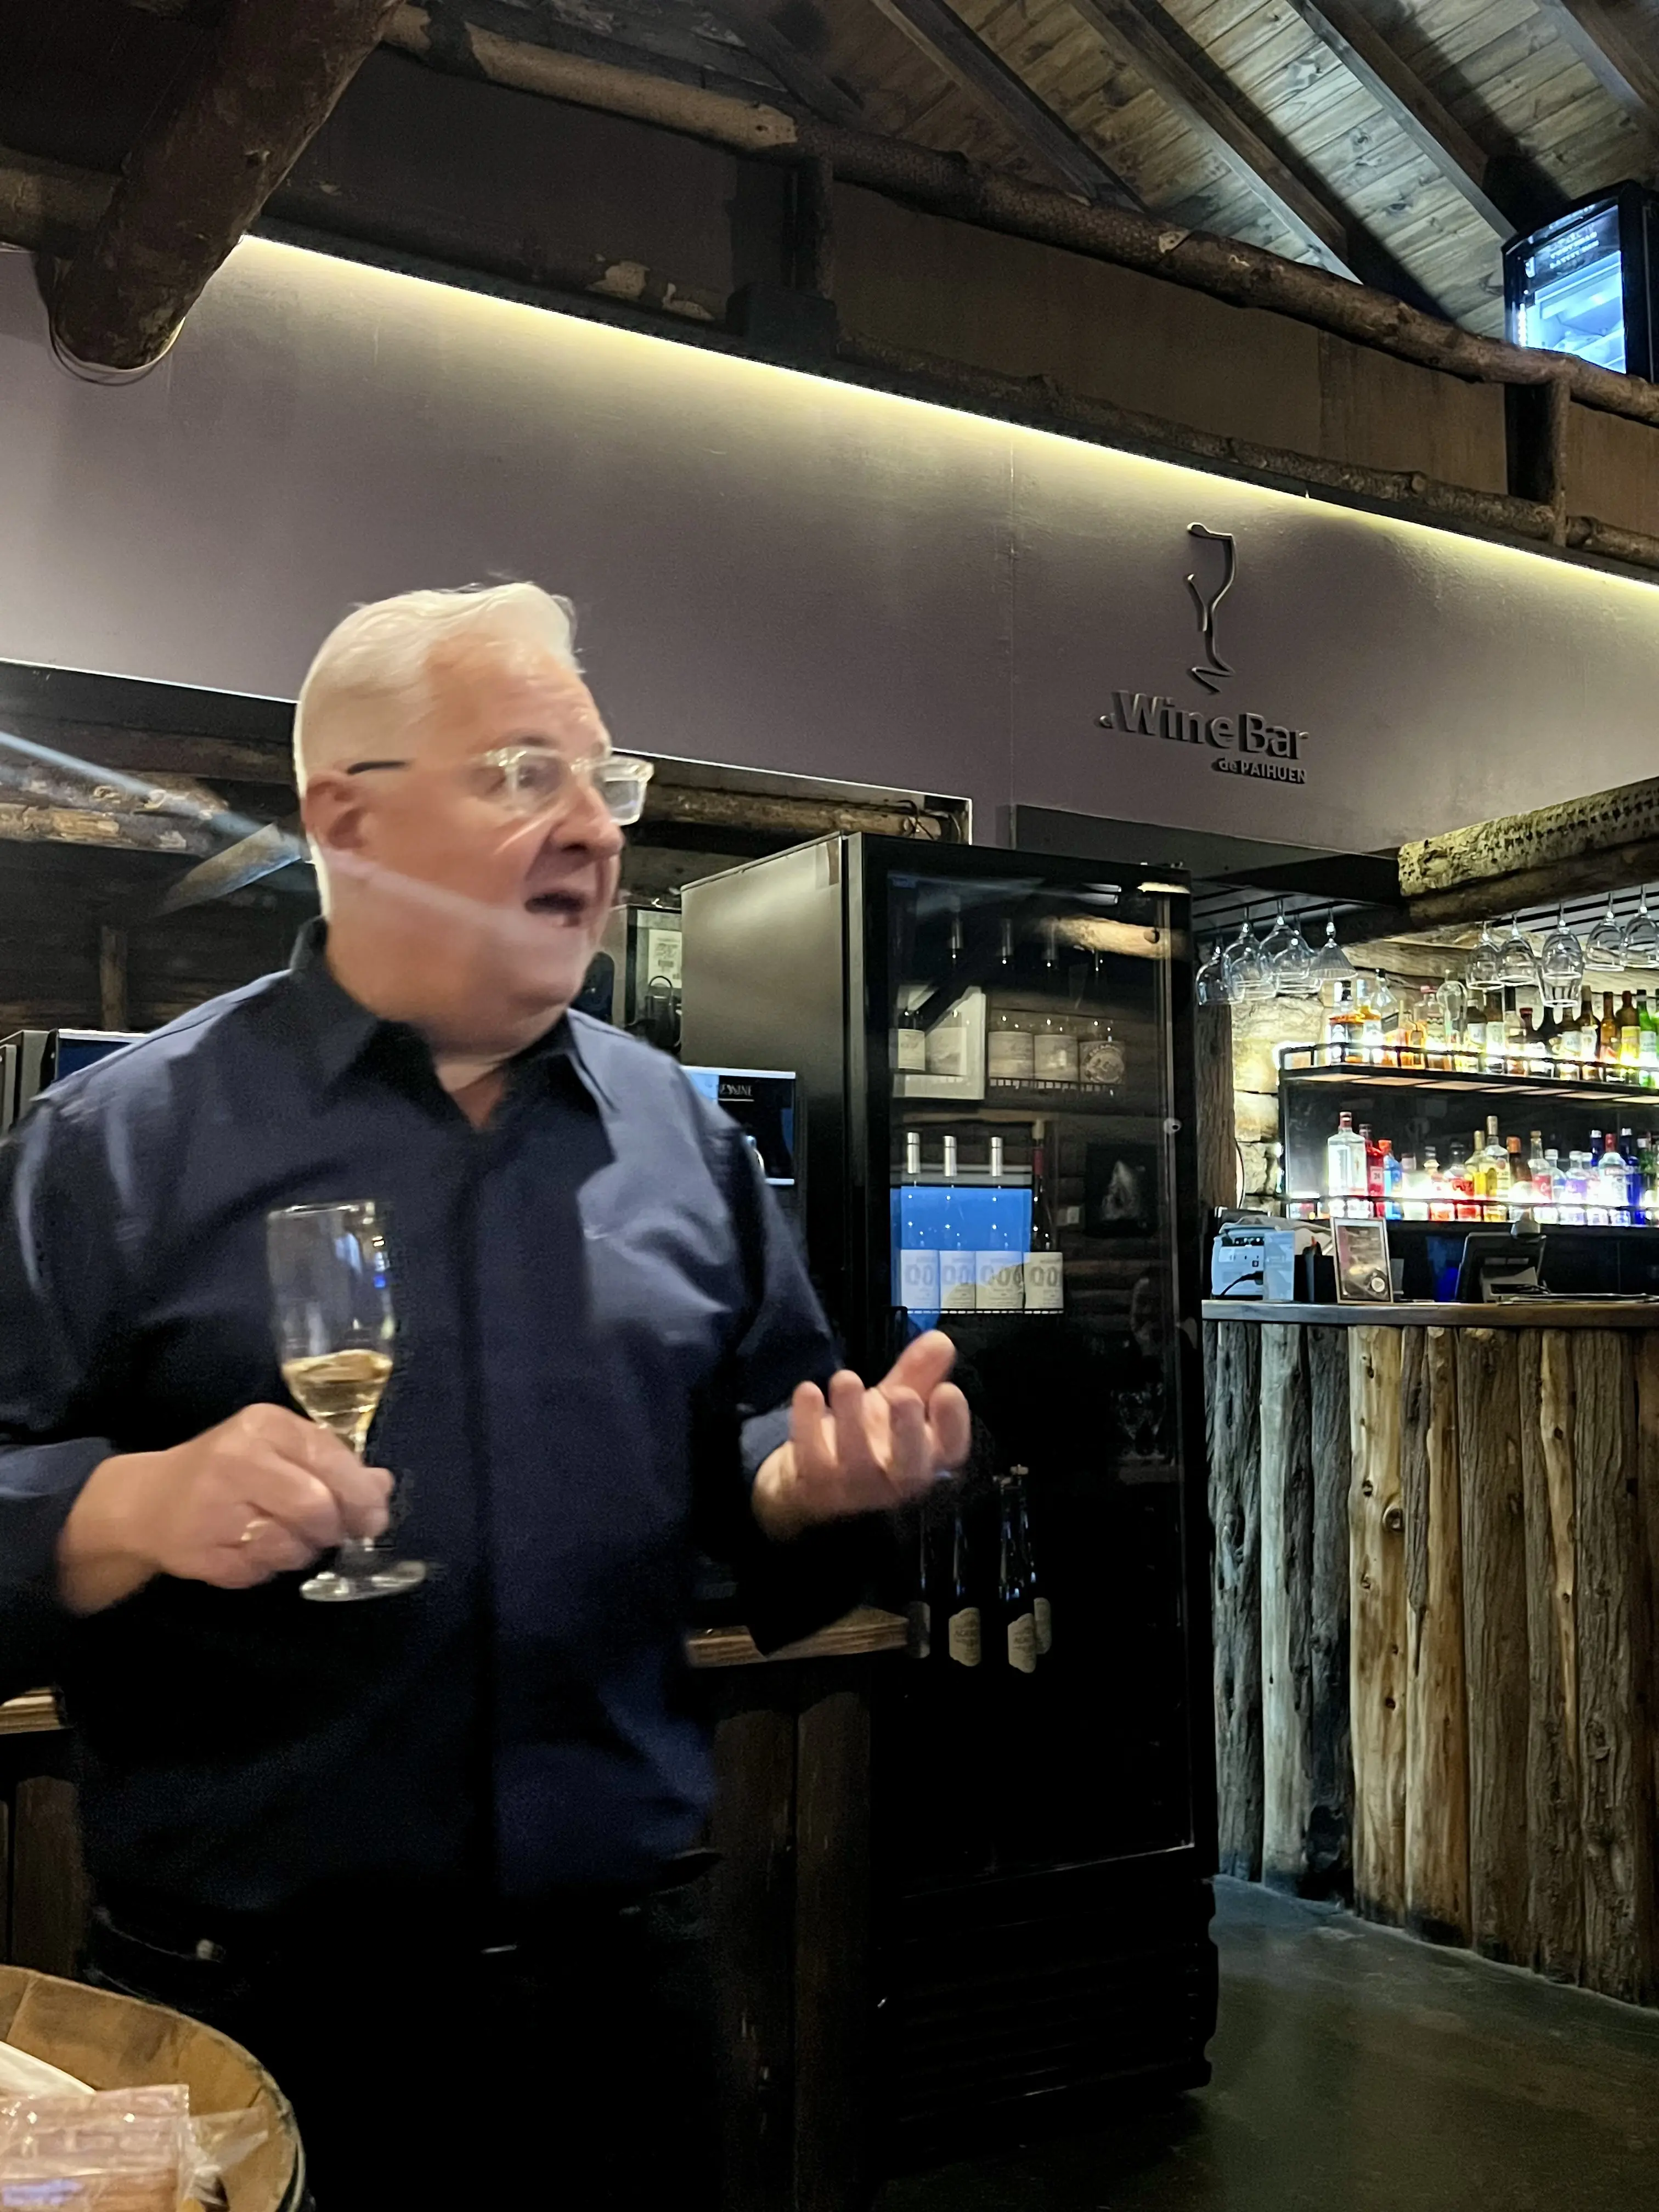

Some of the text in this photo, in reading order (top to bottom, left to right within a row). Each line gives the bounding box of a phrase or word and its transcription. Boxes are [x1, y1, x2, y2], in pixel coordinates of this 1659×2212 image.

[1102, 690, 1309, 759] Wine Bar
[1216, 758, 1307, 784] de PAIHUEN
